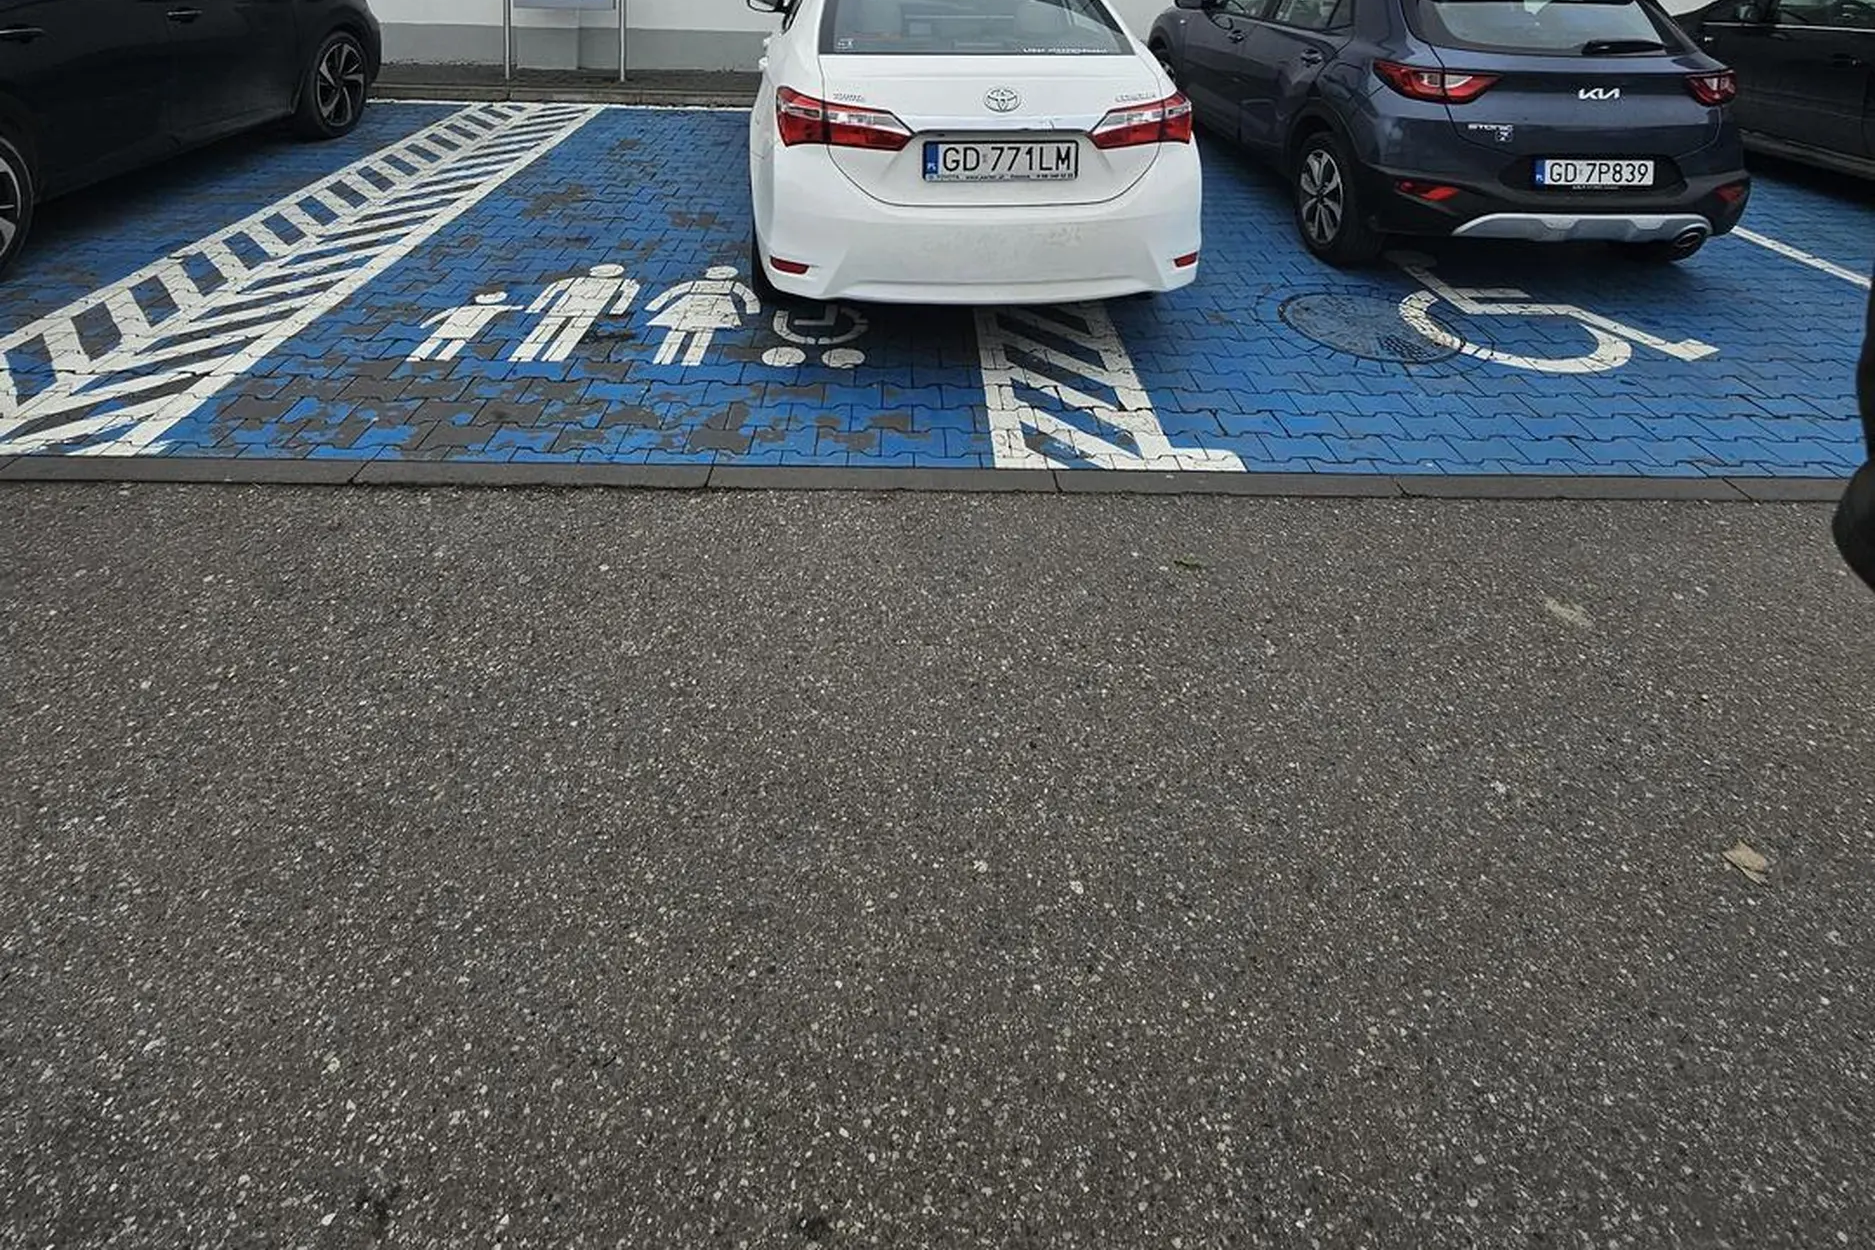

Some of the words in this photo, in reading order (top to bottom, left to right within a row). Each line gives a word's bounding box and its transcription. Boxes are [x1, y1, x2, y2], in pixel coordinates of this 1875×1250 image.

[1578, 87, 1620, 100] KIA
[943, 146, 980, 172] GD
[991, 146, 1071, 172] 771LM
[1550, 162, 1577, 183] GD
[1586, 162, 1648, 183] 7P839
